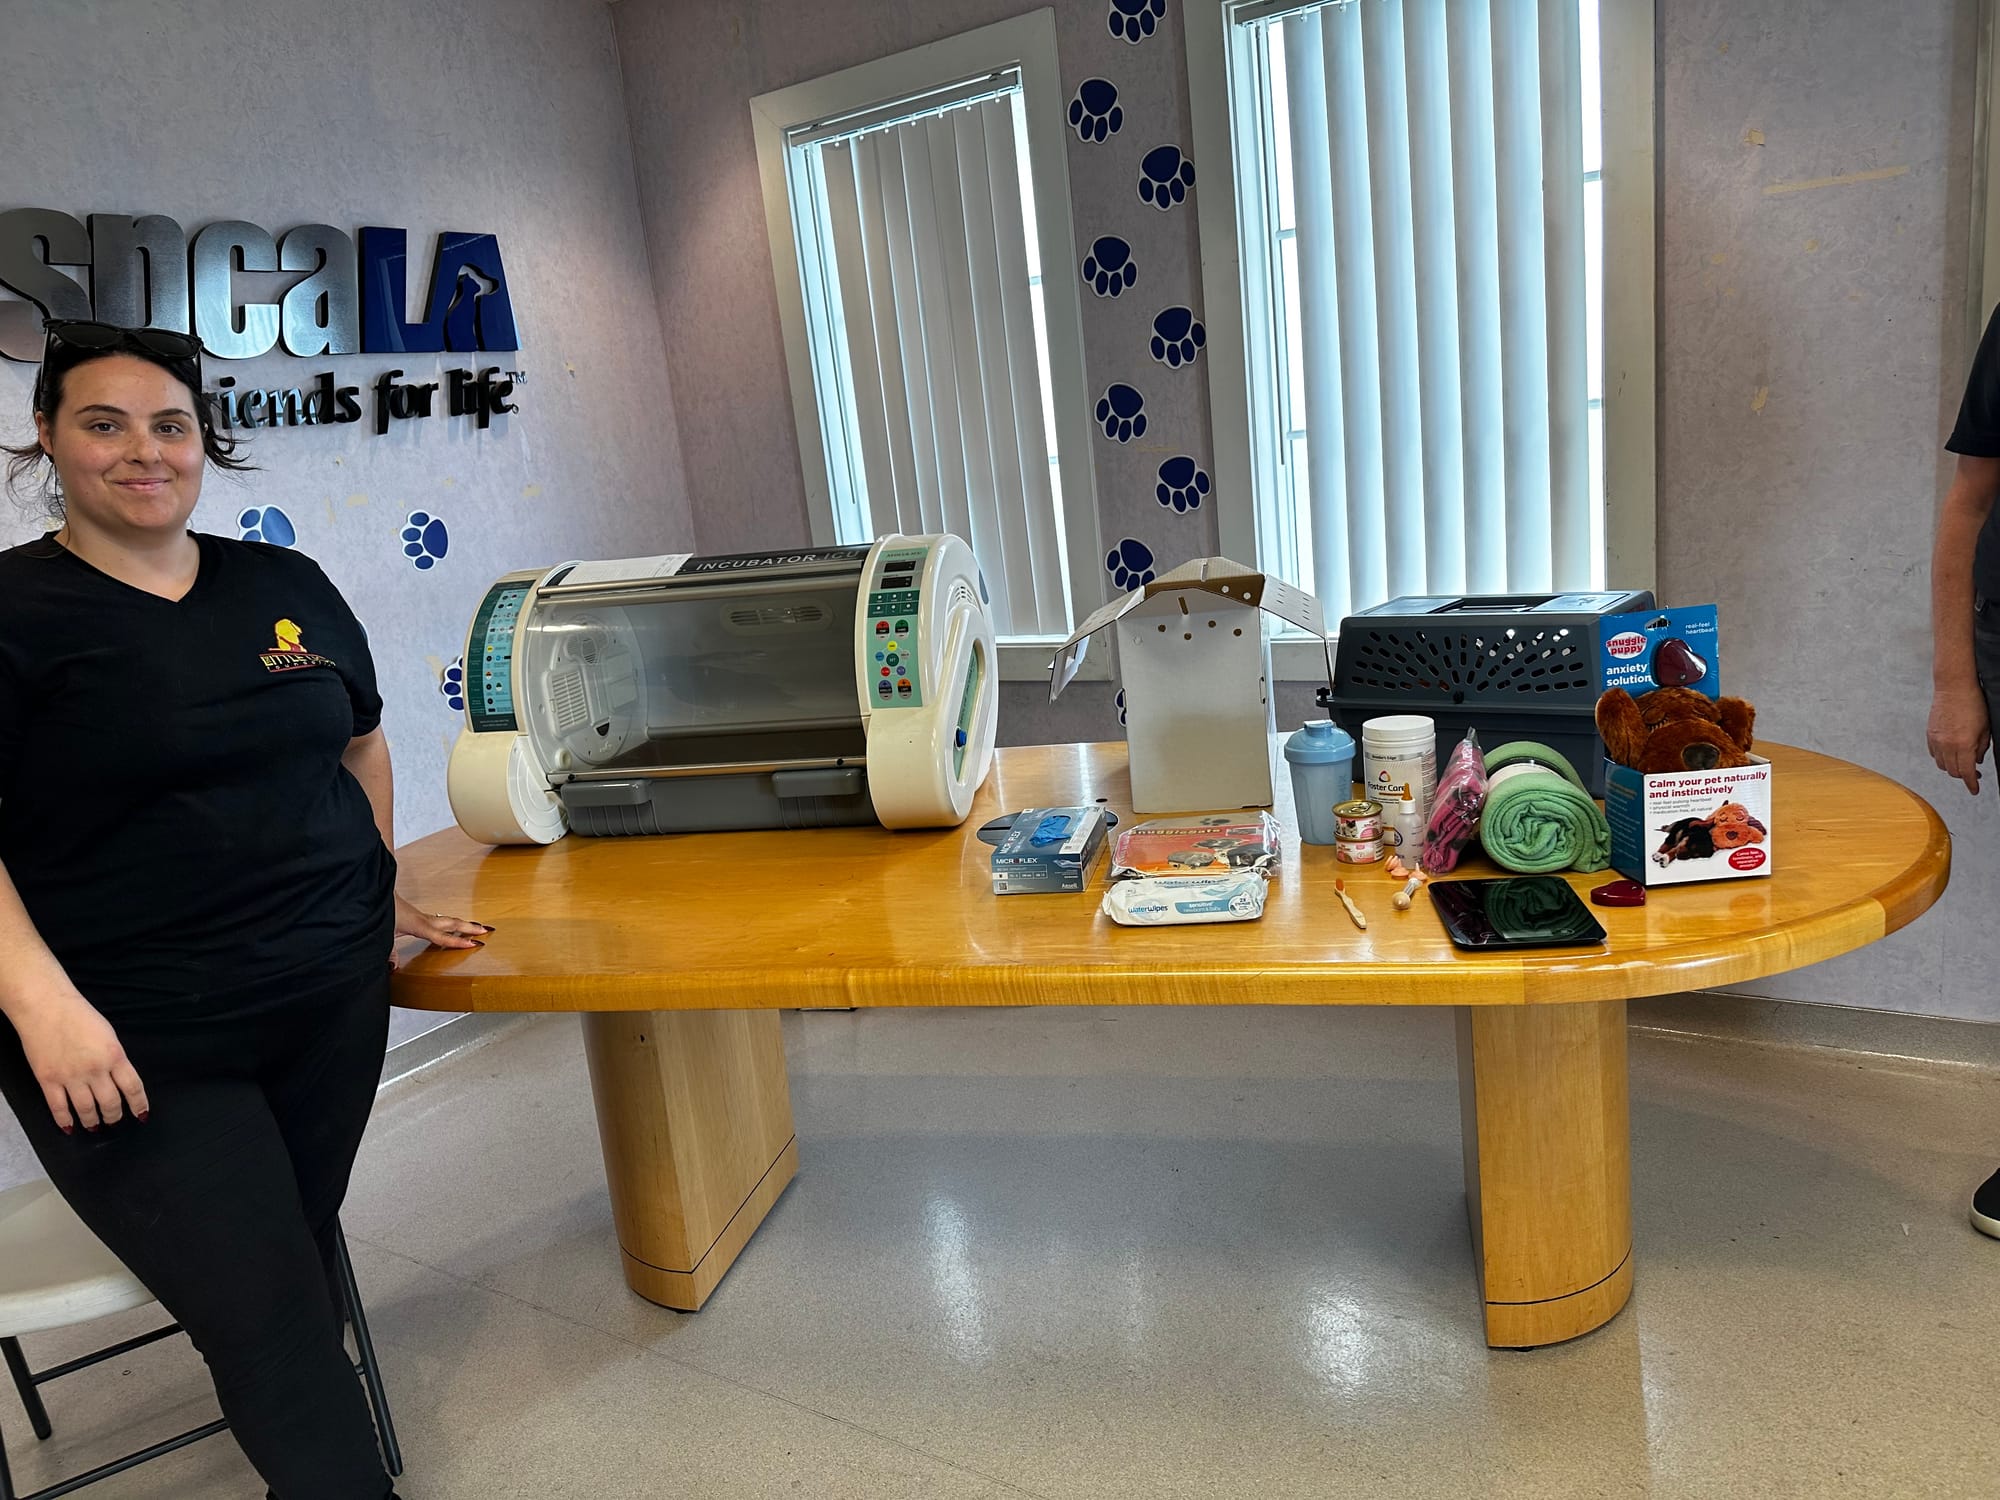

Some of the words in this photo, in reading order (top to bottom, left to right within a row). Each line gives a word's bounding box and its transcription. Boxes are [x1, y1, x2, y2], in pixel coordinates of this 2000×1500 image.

[371, 369, 440, 435] for
[696, 554, 817, 571] INCUBATOR
[1606, 636, 1647, 649] snuggle
[1610, 645, 1644, 657] puppy
[1606, 663, 1648, 676] anxiety
[1606, 674, 1652, 687] solution
[1648, 779, 1676, 789] Calm
[1679, 778, 1702, 788] your
[1704, 775, 1722, 786] pet
[1724, 771, 1768, 784] naturally
[1649, 789, 1669, 799] and
[1671, 785, 1734, 798] instinctively
